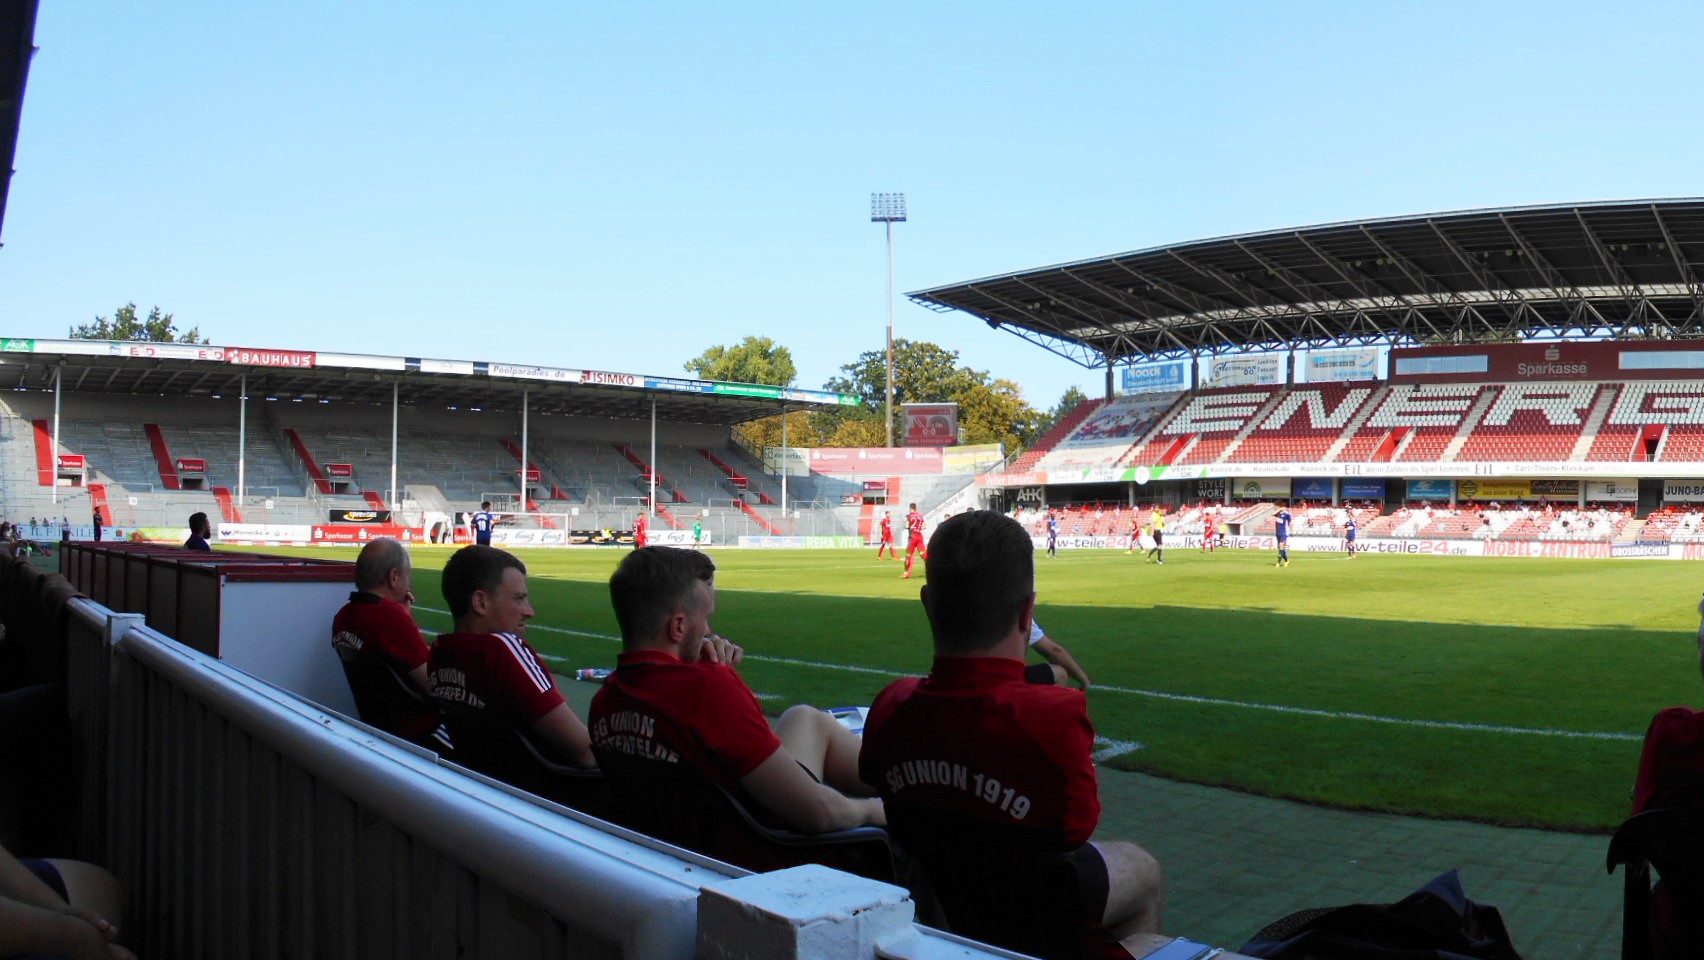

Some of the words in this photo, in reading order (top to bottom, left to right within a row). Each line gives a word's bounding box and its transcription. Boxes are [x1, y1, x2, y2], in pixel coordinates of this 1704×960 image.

[242, 352, 311, 366] BAUHAUS
[1518, 362, 1588, 377] Sparkasse
[821, 453, 847, 461] Sparkasse
[868, 452, 893, 460] Sparkasse
[914, 452, 939, 460] Sparkasse
[984, 475, 1006, 485] Voller
[1199, 479, 1224, 489] STYLE
[1198, 489, 1223, 498] WORK
[325, 532, 353, 541] Sparkasse
[438, 667, 466, 688] UNION
[610, 709, 656, 738] UNION
[885, 766, 905, 794] SG
[903, 758, 968, 791] UNION
[973, 772, 1032, 820] 1919
